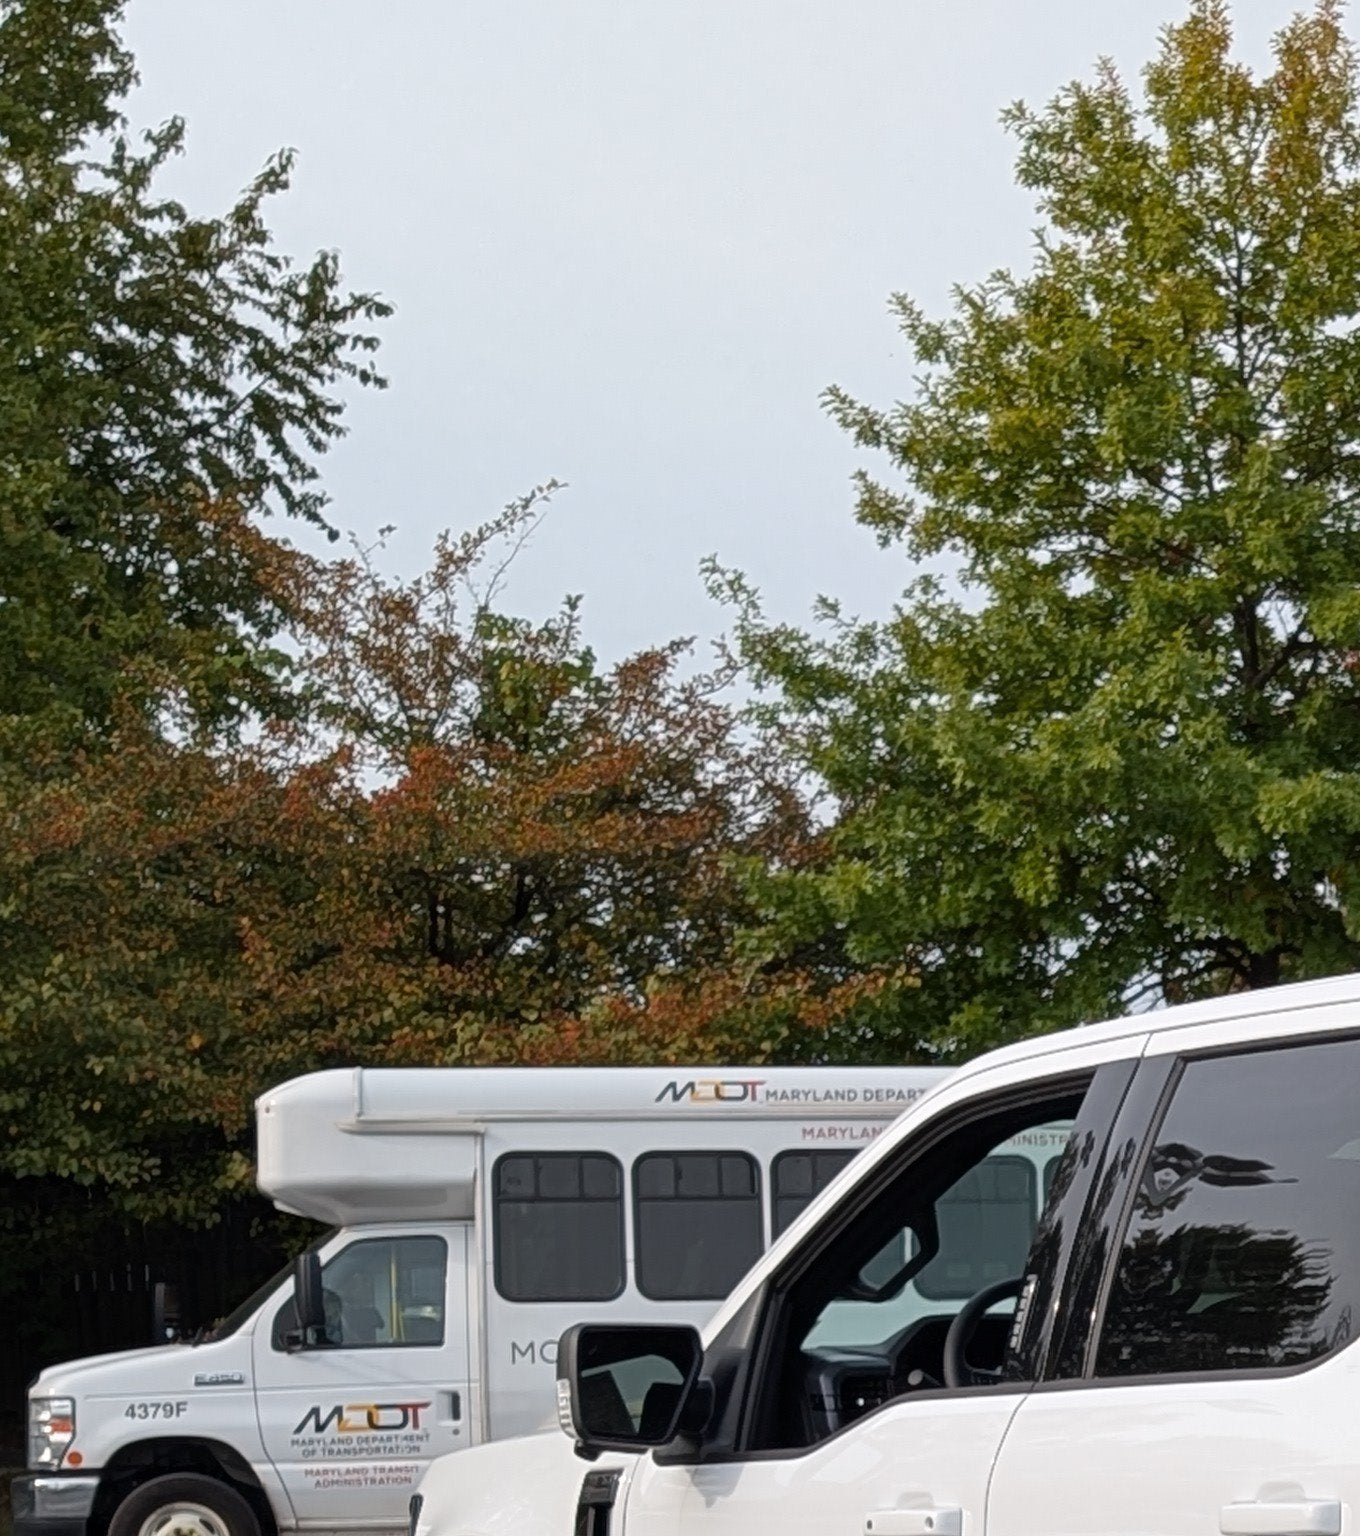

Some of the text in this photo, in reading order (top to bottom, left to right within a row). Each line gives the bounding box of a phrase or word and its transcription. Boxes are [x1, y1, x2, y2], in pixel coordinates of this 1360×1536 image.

[766, 1088, 857, 1102] MARYLAND
[125, 1401, 188, 1420] 4379F
[290, 1433, 431, 1447] MARYLAND DEPARTMENT
[301, 1445, 421, 1458] OF TRANSPORTATION
[304, 1465, 420, 1477] MARYLAND TRANSIT
[314, 1477, 412, 1489] ADMINISTRATION
